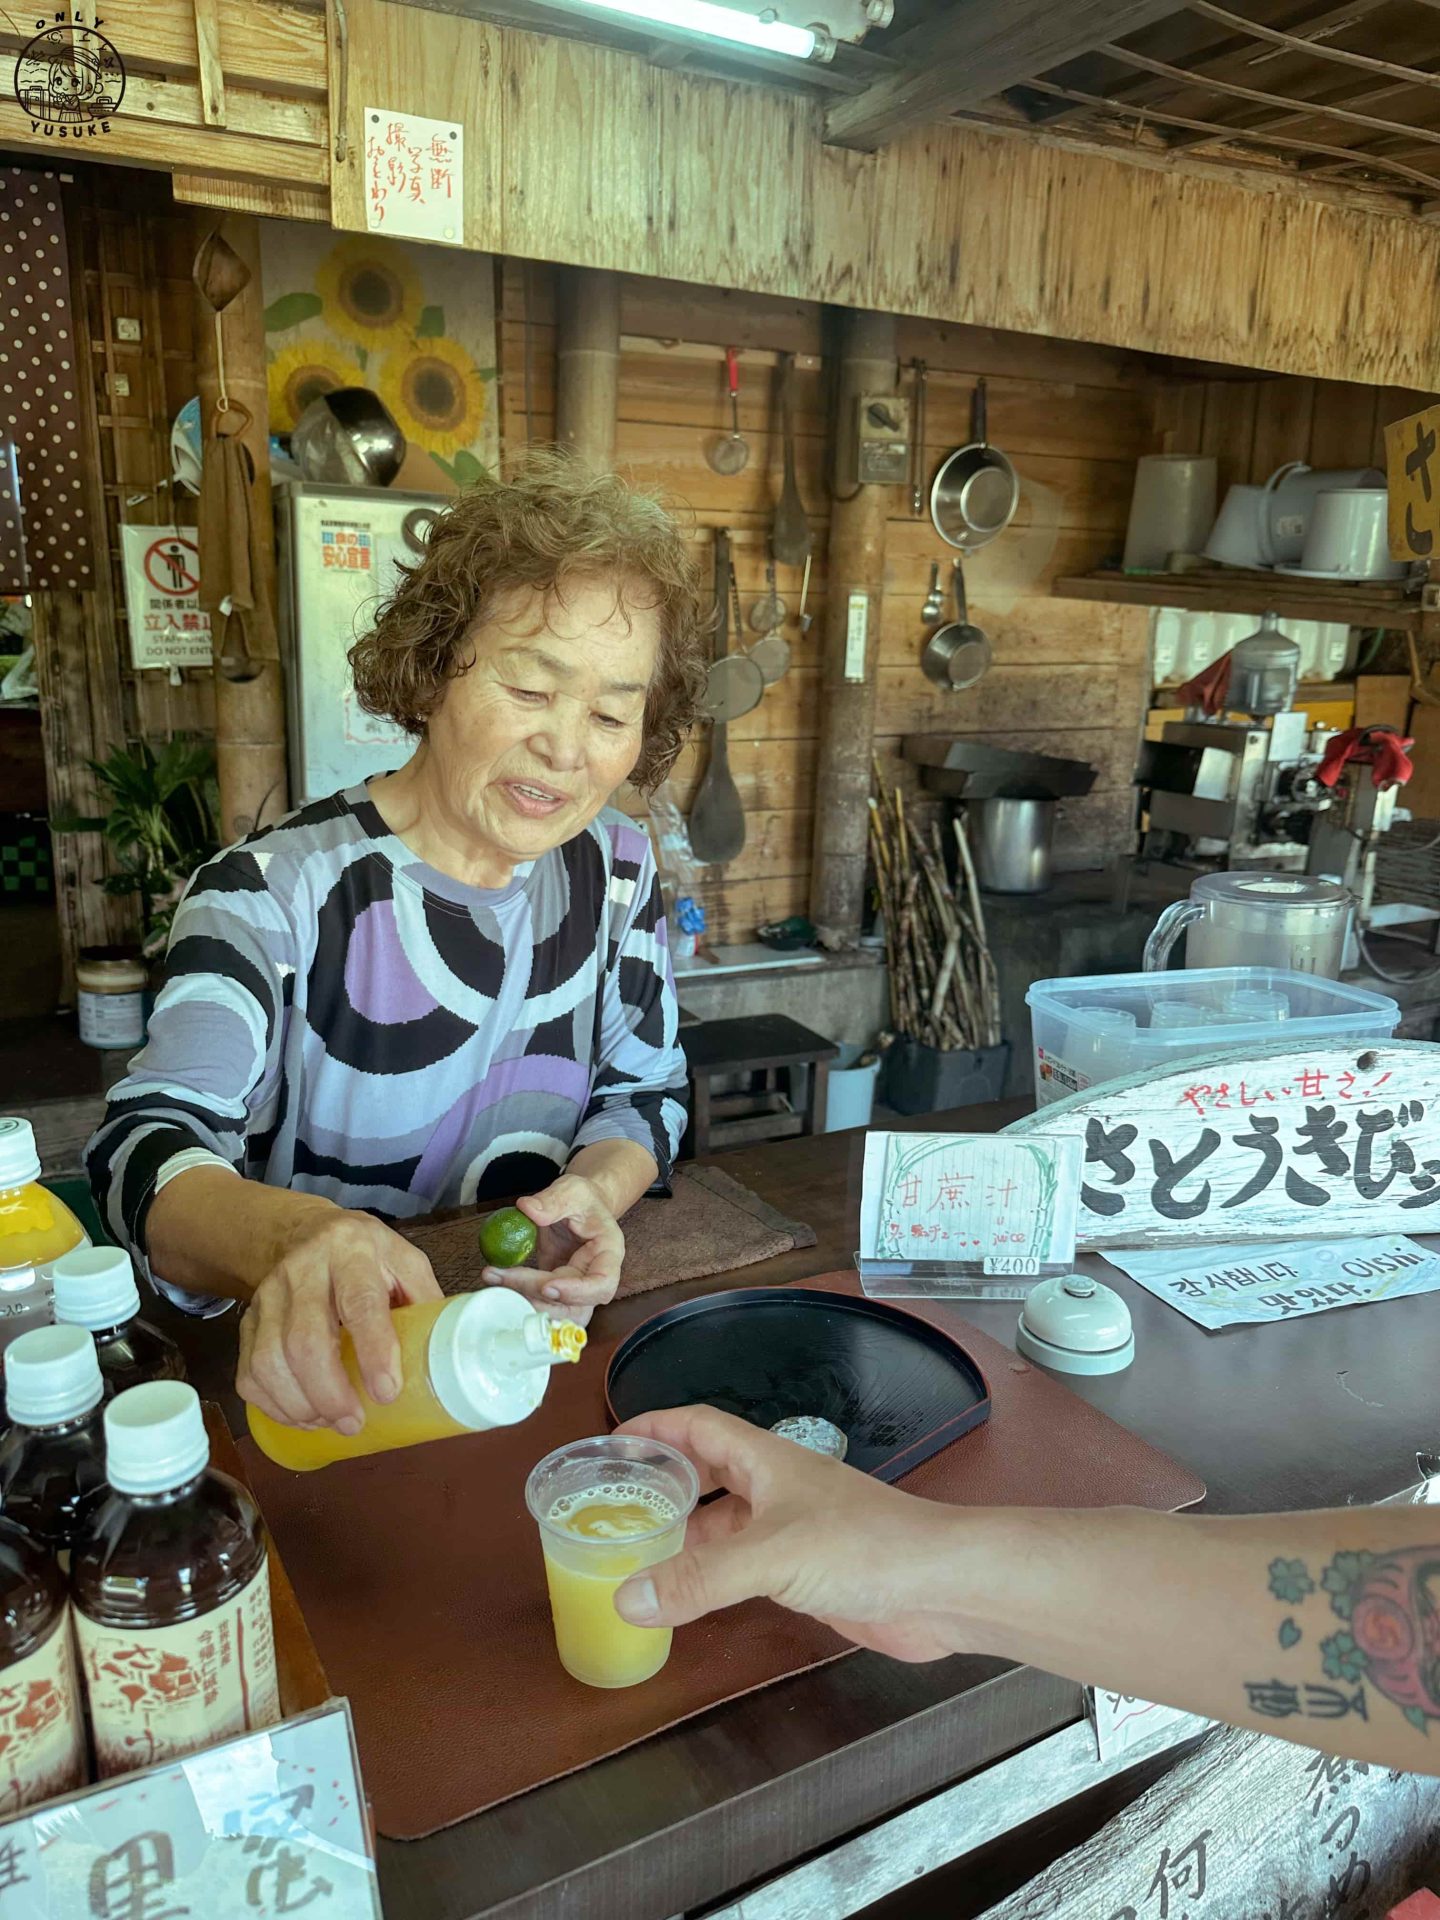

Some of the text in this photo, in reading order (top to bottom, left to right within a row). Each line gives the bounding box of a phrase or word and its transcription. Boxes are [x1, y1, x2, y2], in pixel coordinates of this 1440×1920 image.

[146, 647, 163, 656] DO
[165, 647, 186, 656] NOT
[989, 1258, 1036, 1274] ¥400
